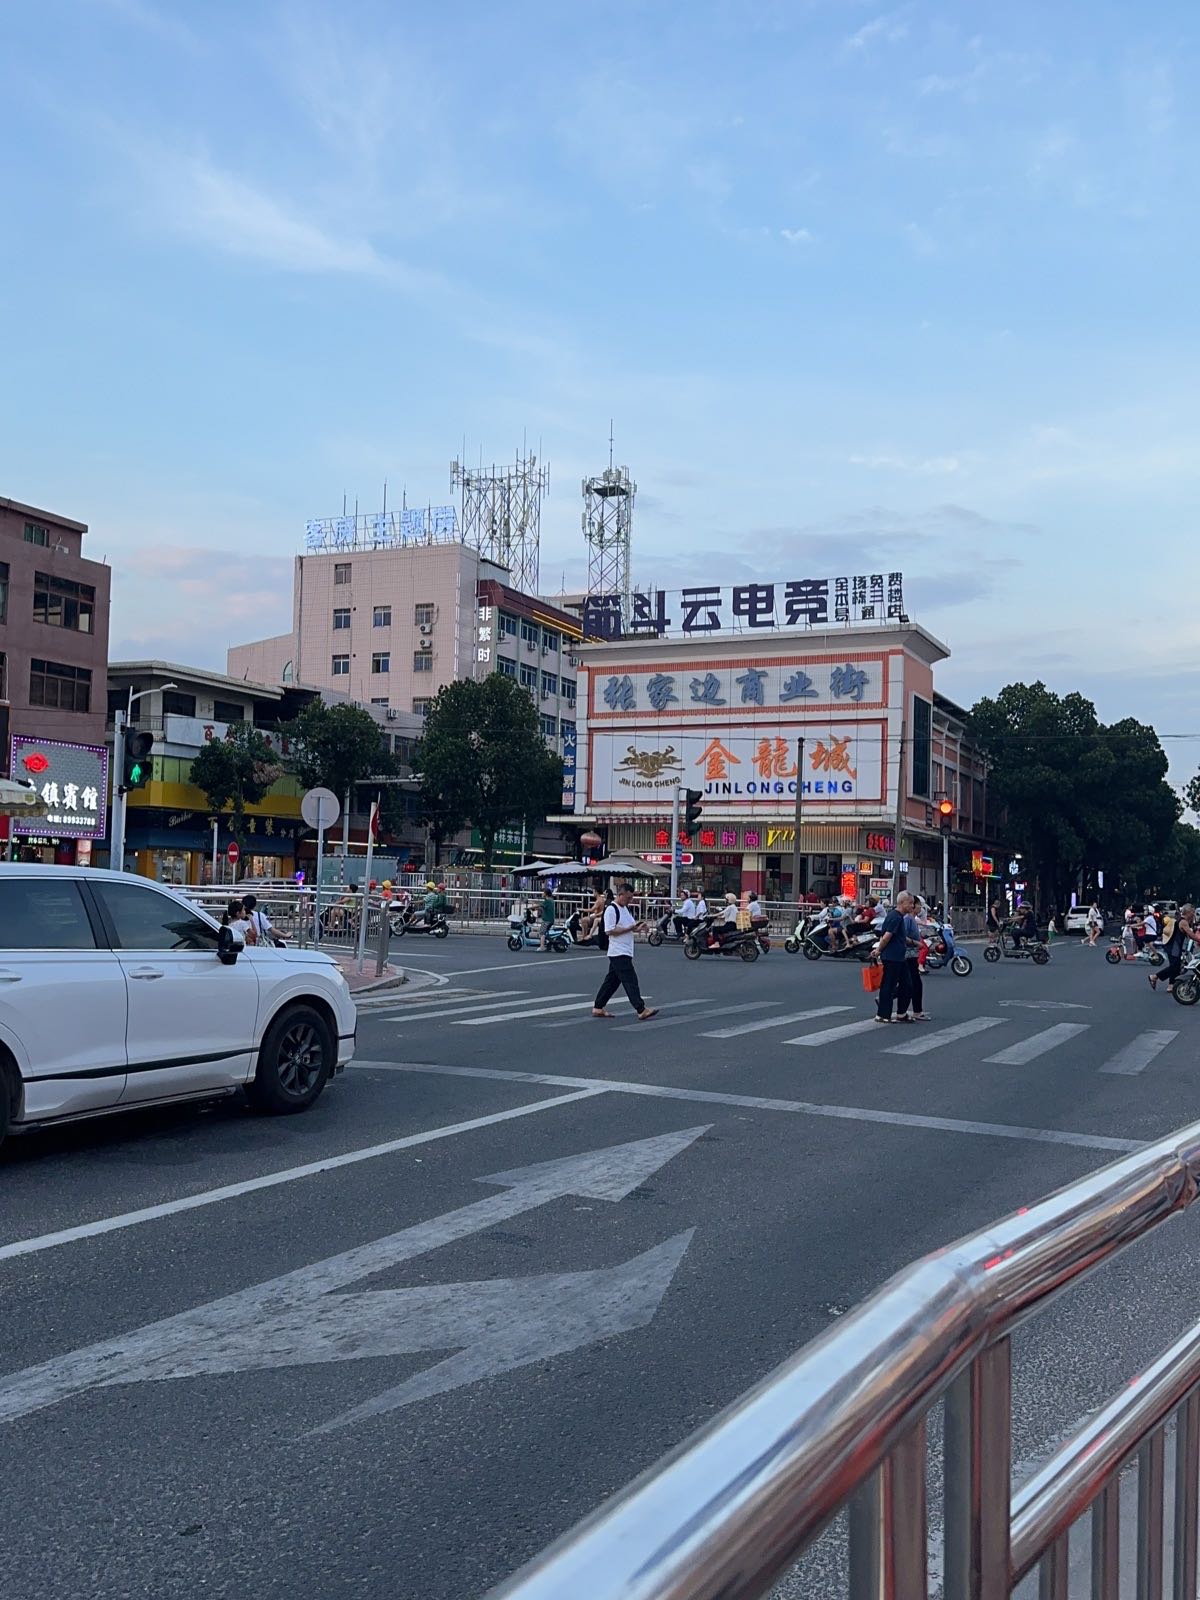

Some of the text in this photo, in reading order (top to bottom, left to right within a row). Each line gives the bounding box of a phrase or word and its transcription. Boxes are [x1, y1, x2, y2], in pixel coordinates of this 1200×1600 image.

[835, 572, 902, 591] 全场免费
[835, 587, 902, 606] 本栋三楼
[583, 579, 829, 639] 筋斗云电竞
[603, 663, 870, 711] 张家边商业街
[563, 734, 576, 789] 火车票
[695, 734, 858, 781] 金龍城
[28, 778, 98, 811] 镇宾馆
[619, 776, 681, 788] JIN LONG CHENG
